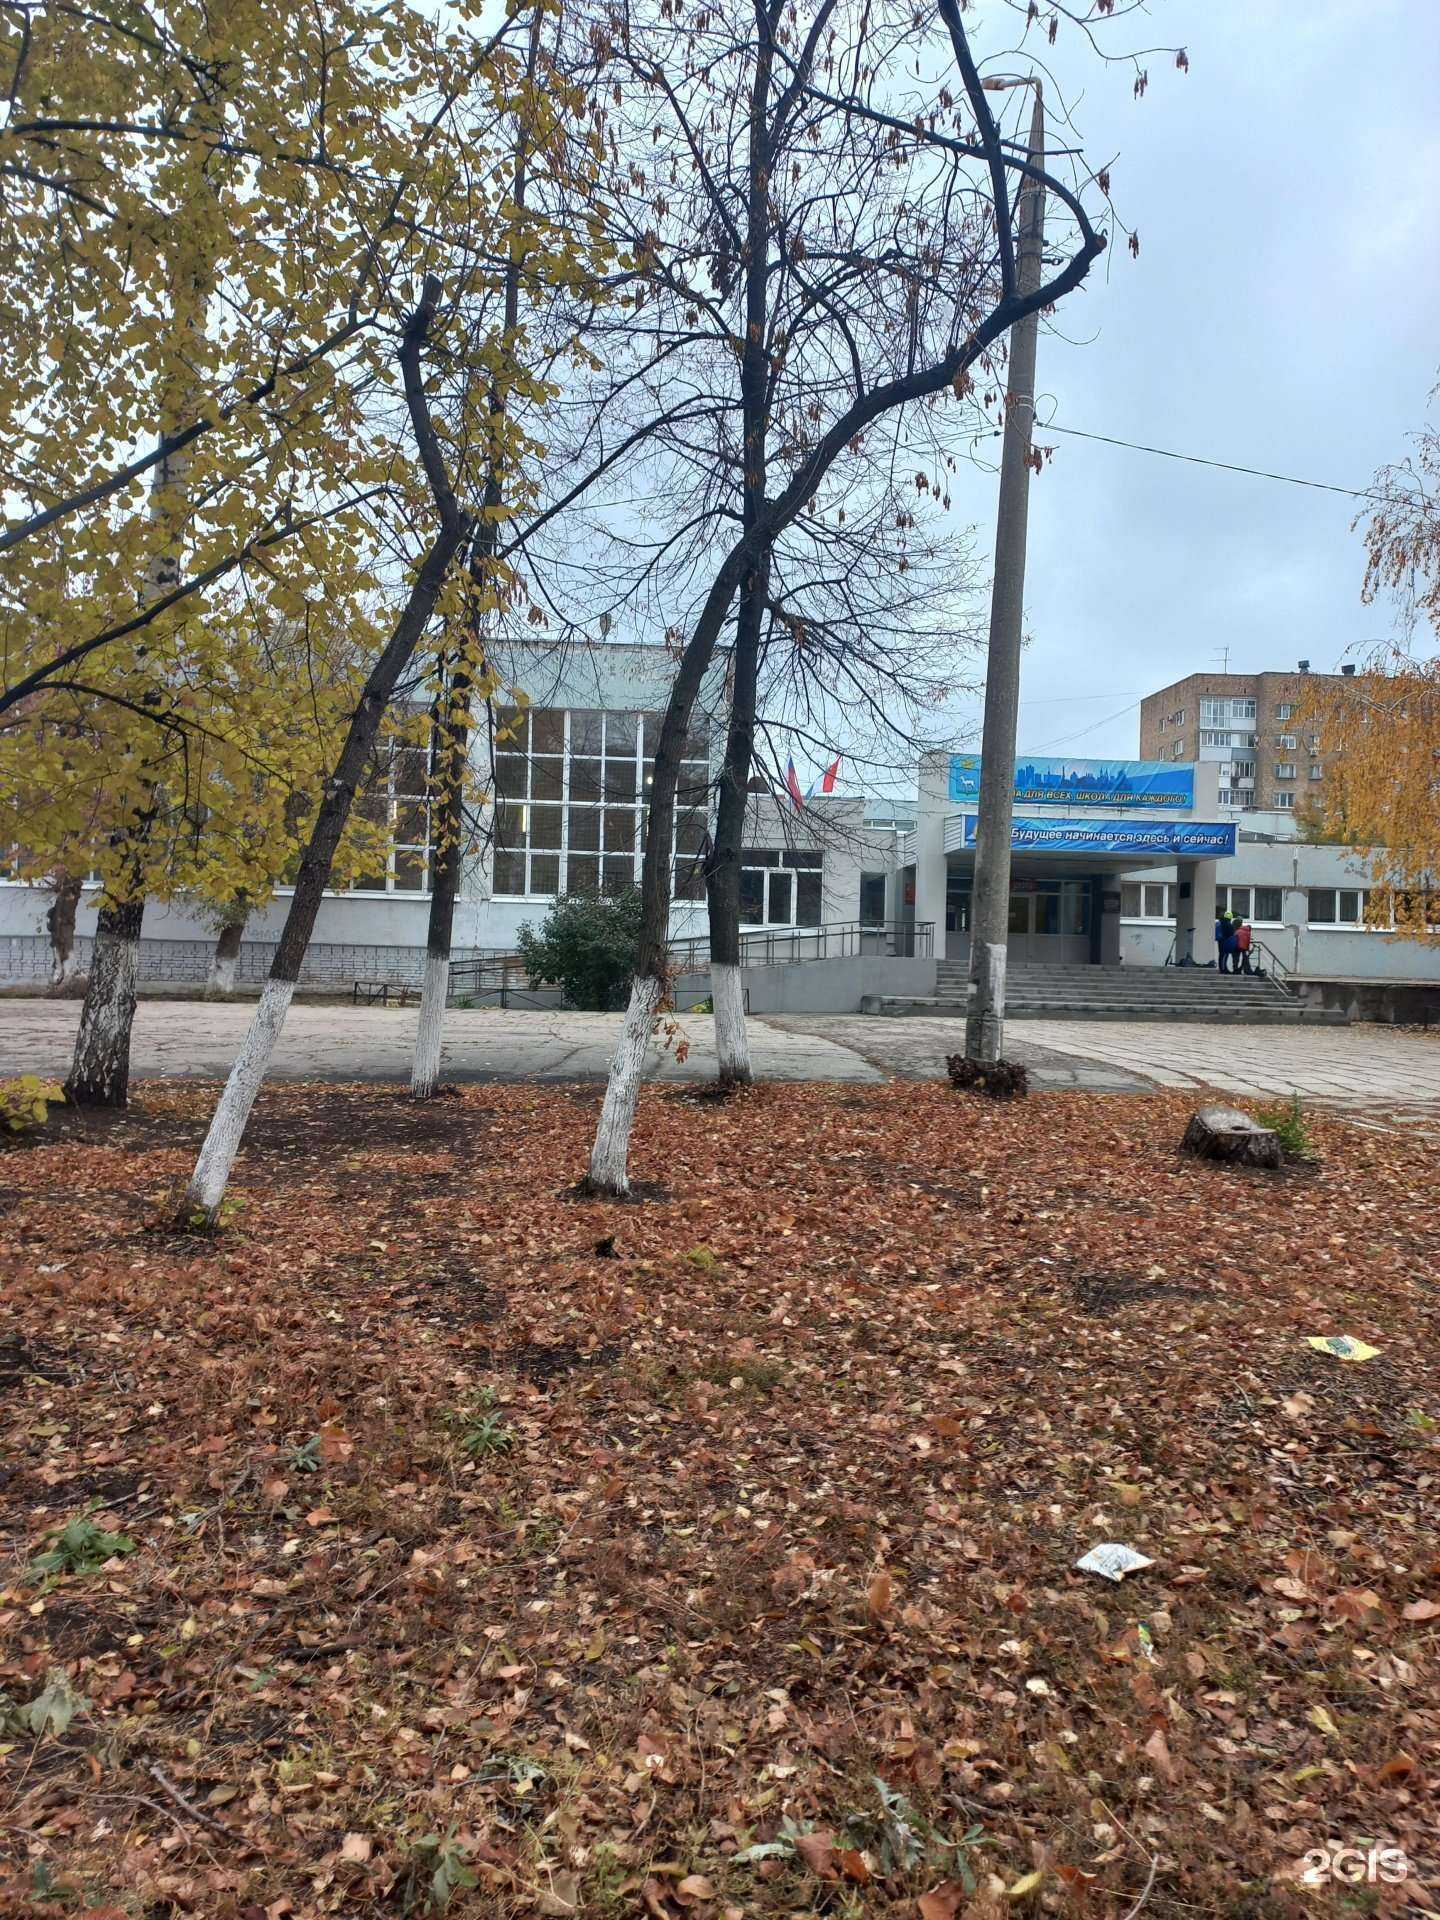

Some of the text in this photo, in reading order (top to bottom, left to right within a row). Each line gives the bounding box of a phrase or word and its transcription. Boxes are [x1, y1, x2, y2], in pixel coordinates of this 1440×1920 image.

[1023, 791, 1044, 800] ДЛЯ
[1076, 792, 1110, 801] ШКОЛА
[1112, 792, 1134, 802] ДЛЯ
[1010, 828, 1229, 845] Будущее начинается здесь и сейчас!
